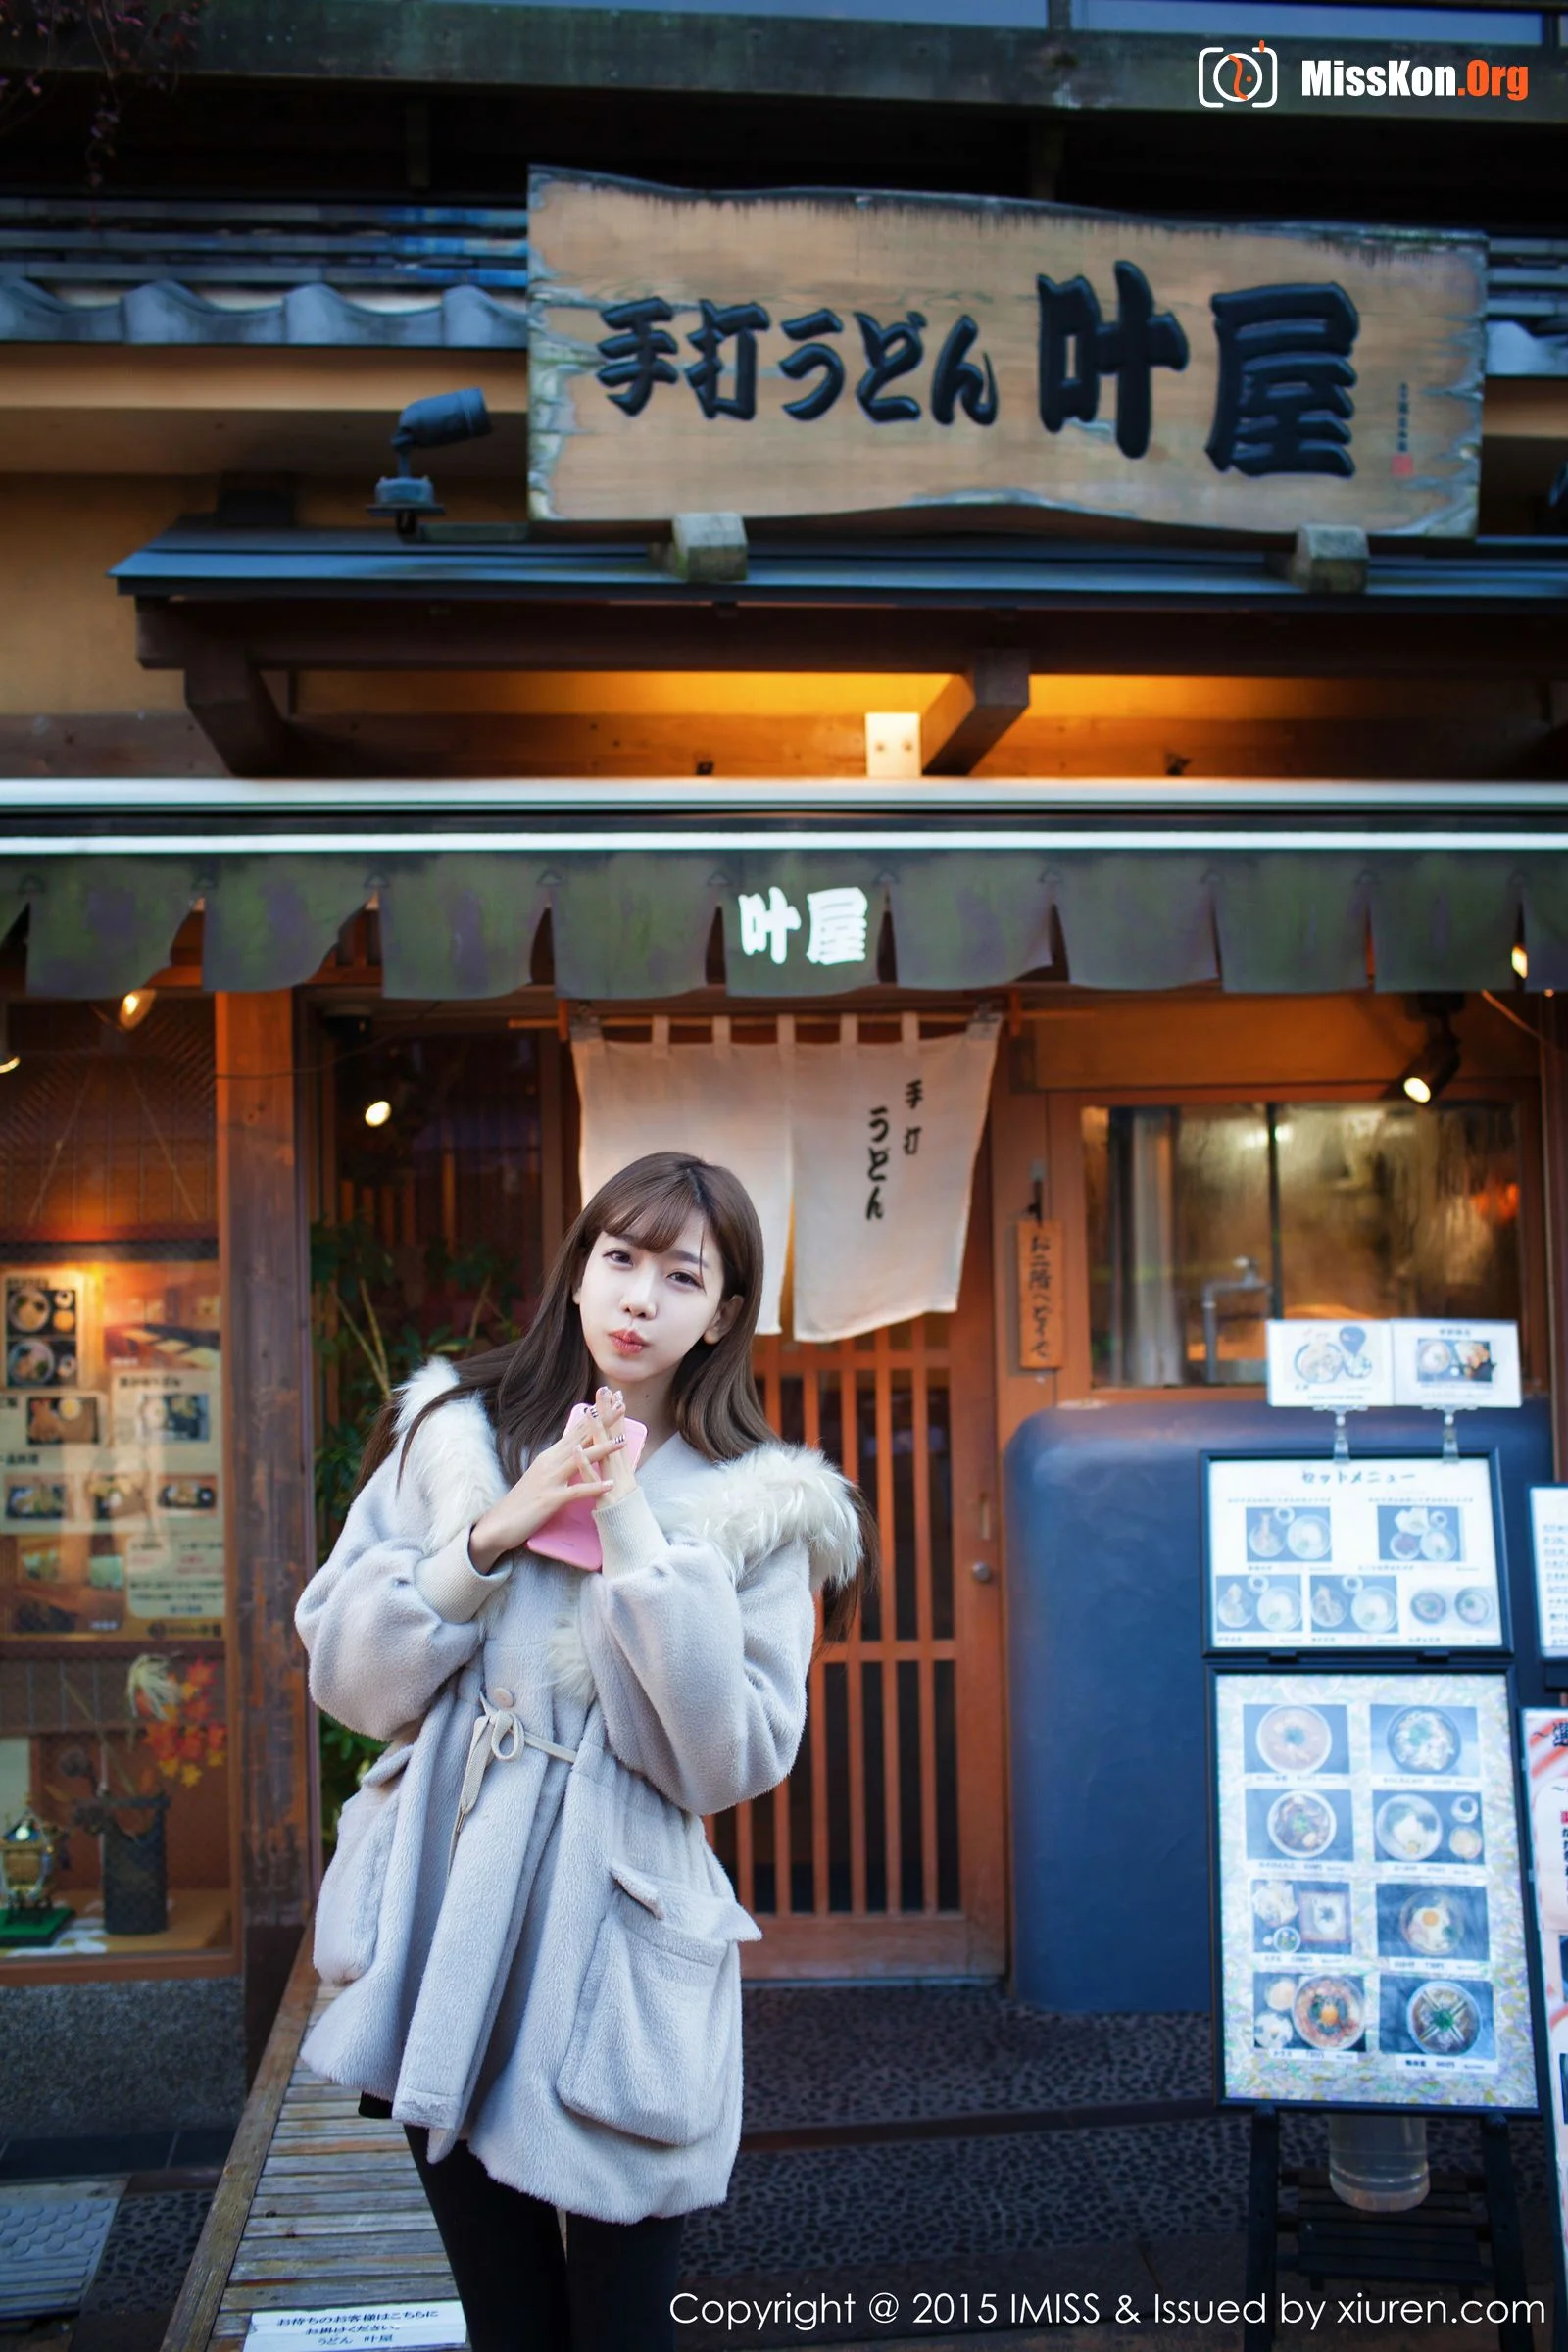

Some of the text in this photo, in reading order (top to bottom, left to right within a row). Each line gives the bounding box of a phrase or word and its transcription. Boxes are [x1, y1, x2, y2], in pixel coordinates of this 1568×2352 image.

[597, 294, 998, 427] 手打うどん
[1036, 259, 1359, 478] 叶屋
[738, 886, 868, 965] 叶屋
[903, 1078, 923, 1155] 手打
[865, 1106, 889, 1221] うどん
[1301, 1470, 1417, 1485] セットメニュー
